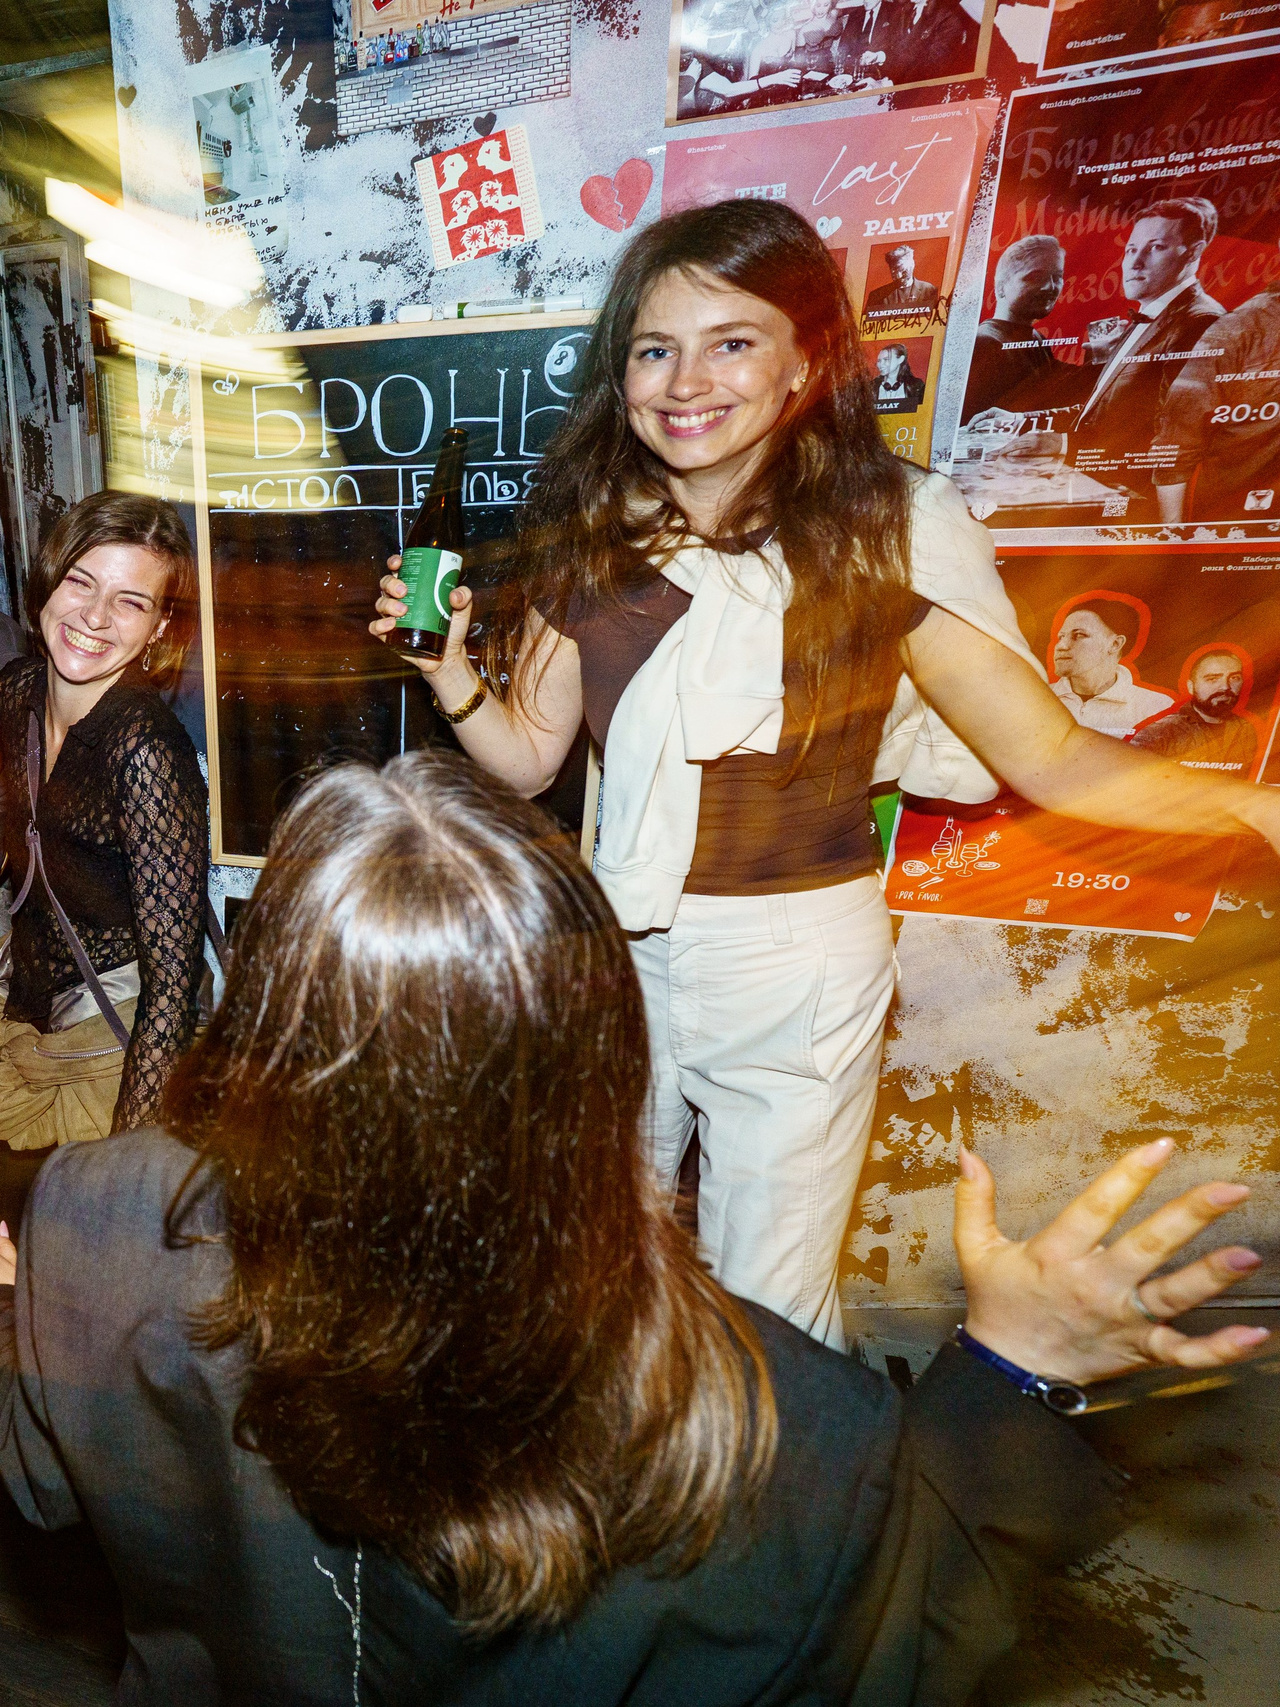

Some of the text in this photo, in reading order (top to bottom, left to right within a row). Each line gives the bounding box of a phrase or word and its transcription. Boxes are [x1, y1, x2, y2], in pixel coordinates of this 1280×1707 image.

[1066, 32, 1127, 50] @heartsbar
[911, 109, 962, 123] Lomonosova,
[687, 143, 727, 154] @heartsbar
[812, 132, 952, 206] Last
[1077, 161, 1129, 175] Гостевая
[1131, 156, 1165, 168] смена
[1168, 151, 1194, 164] бара
[1111, 173, 1136, 187] баре
[1139, 165, 1196, 181] «Midnight
[1198, 158, 1246, 172] Cocktail
[862, 211, 954, 237] PARTY
[868, 306, 931, 318] YAMPOLSKAYA
[1002, 337, 1079, 350] НИКИТА ПЕТРИК
[1121, 348, 1225, 364] ЮРИЙ ГАЛИШНИКОВ
[1214, 371, 1257, 383] ЭДУАРД
[1210, 401, 1280, 424] 20:0
[986, 416, 1055, 437] 13/11
[1051, 871, 1130, 892] 19:30
